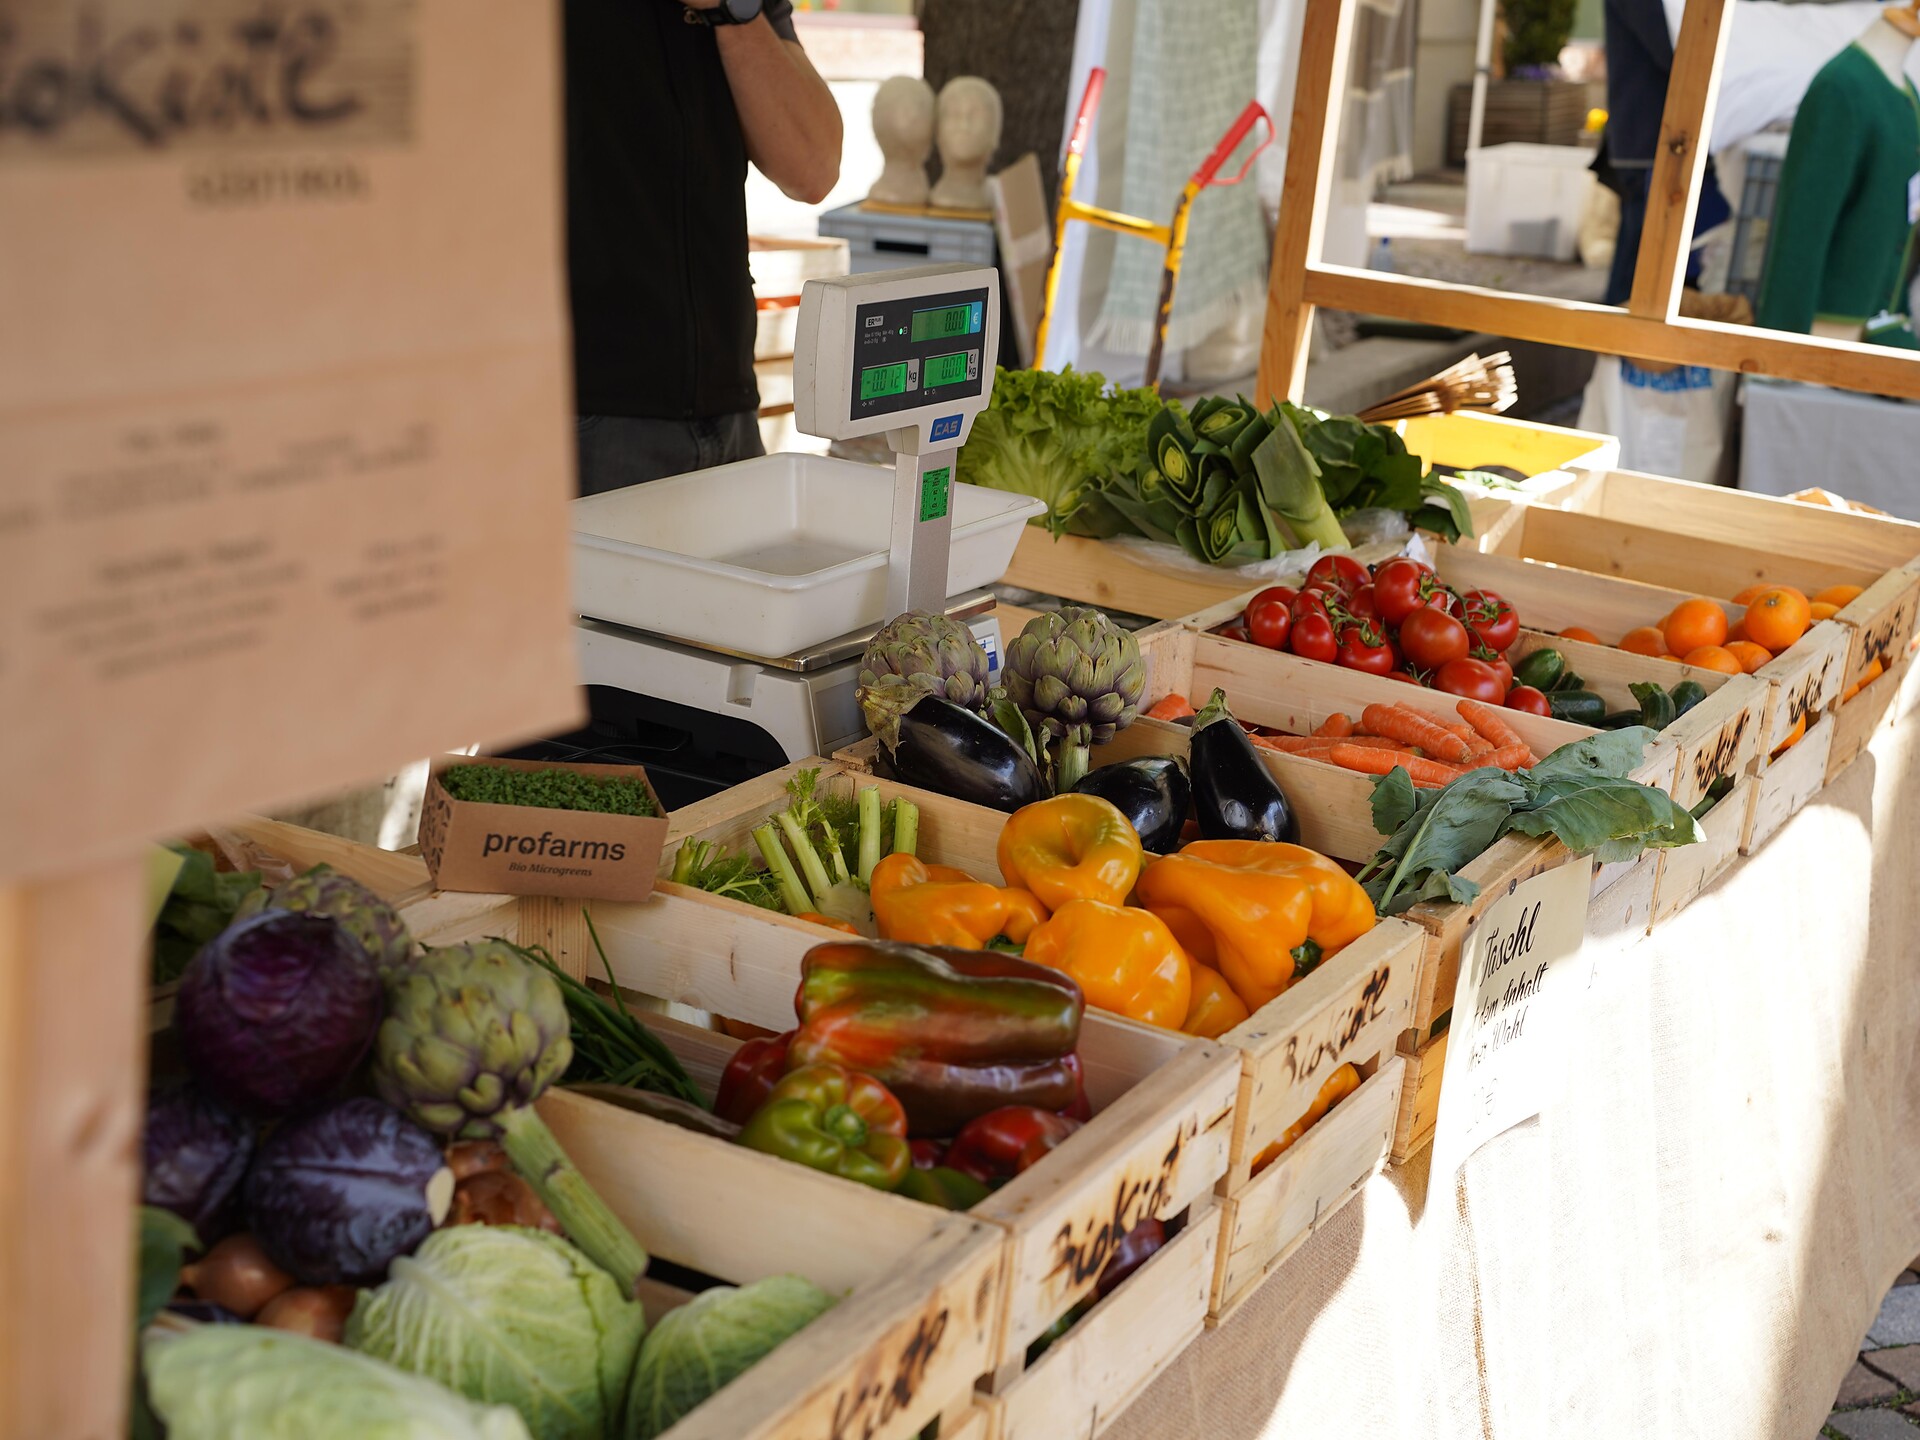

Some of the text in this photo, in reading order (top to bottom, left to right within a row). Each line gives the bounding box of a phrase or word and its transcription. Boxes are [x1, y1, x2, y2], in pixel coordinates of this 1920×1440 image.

[908, 370, 917, 383] kg
[968, 366, 977, 378] kg
[934, 420, 958, 437] CAS
[482, 831, 626, 861] profarms
[508, 861, 593, 877] Bio Microgreens
[1501, 960, 1550, 1012] Inhalt
[1492, 1004, 1529, 1053] Wahl
